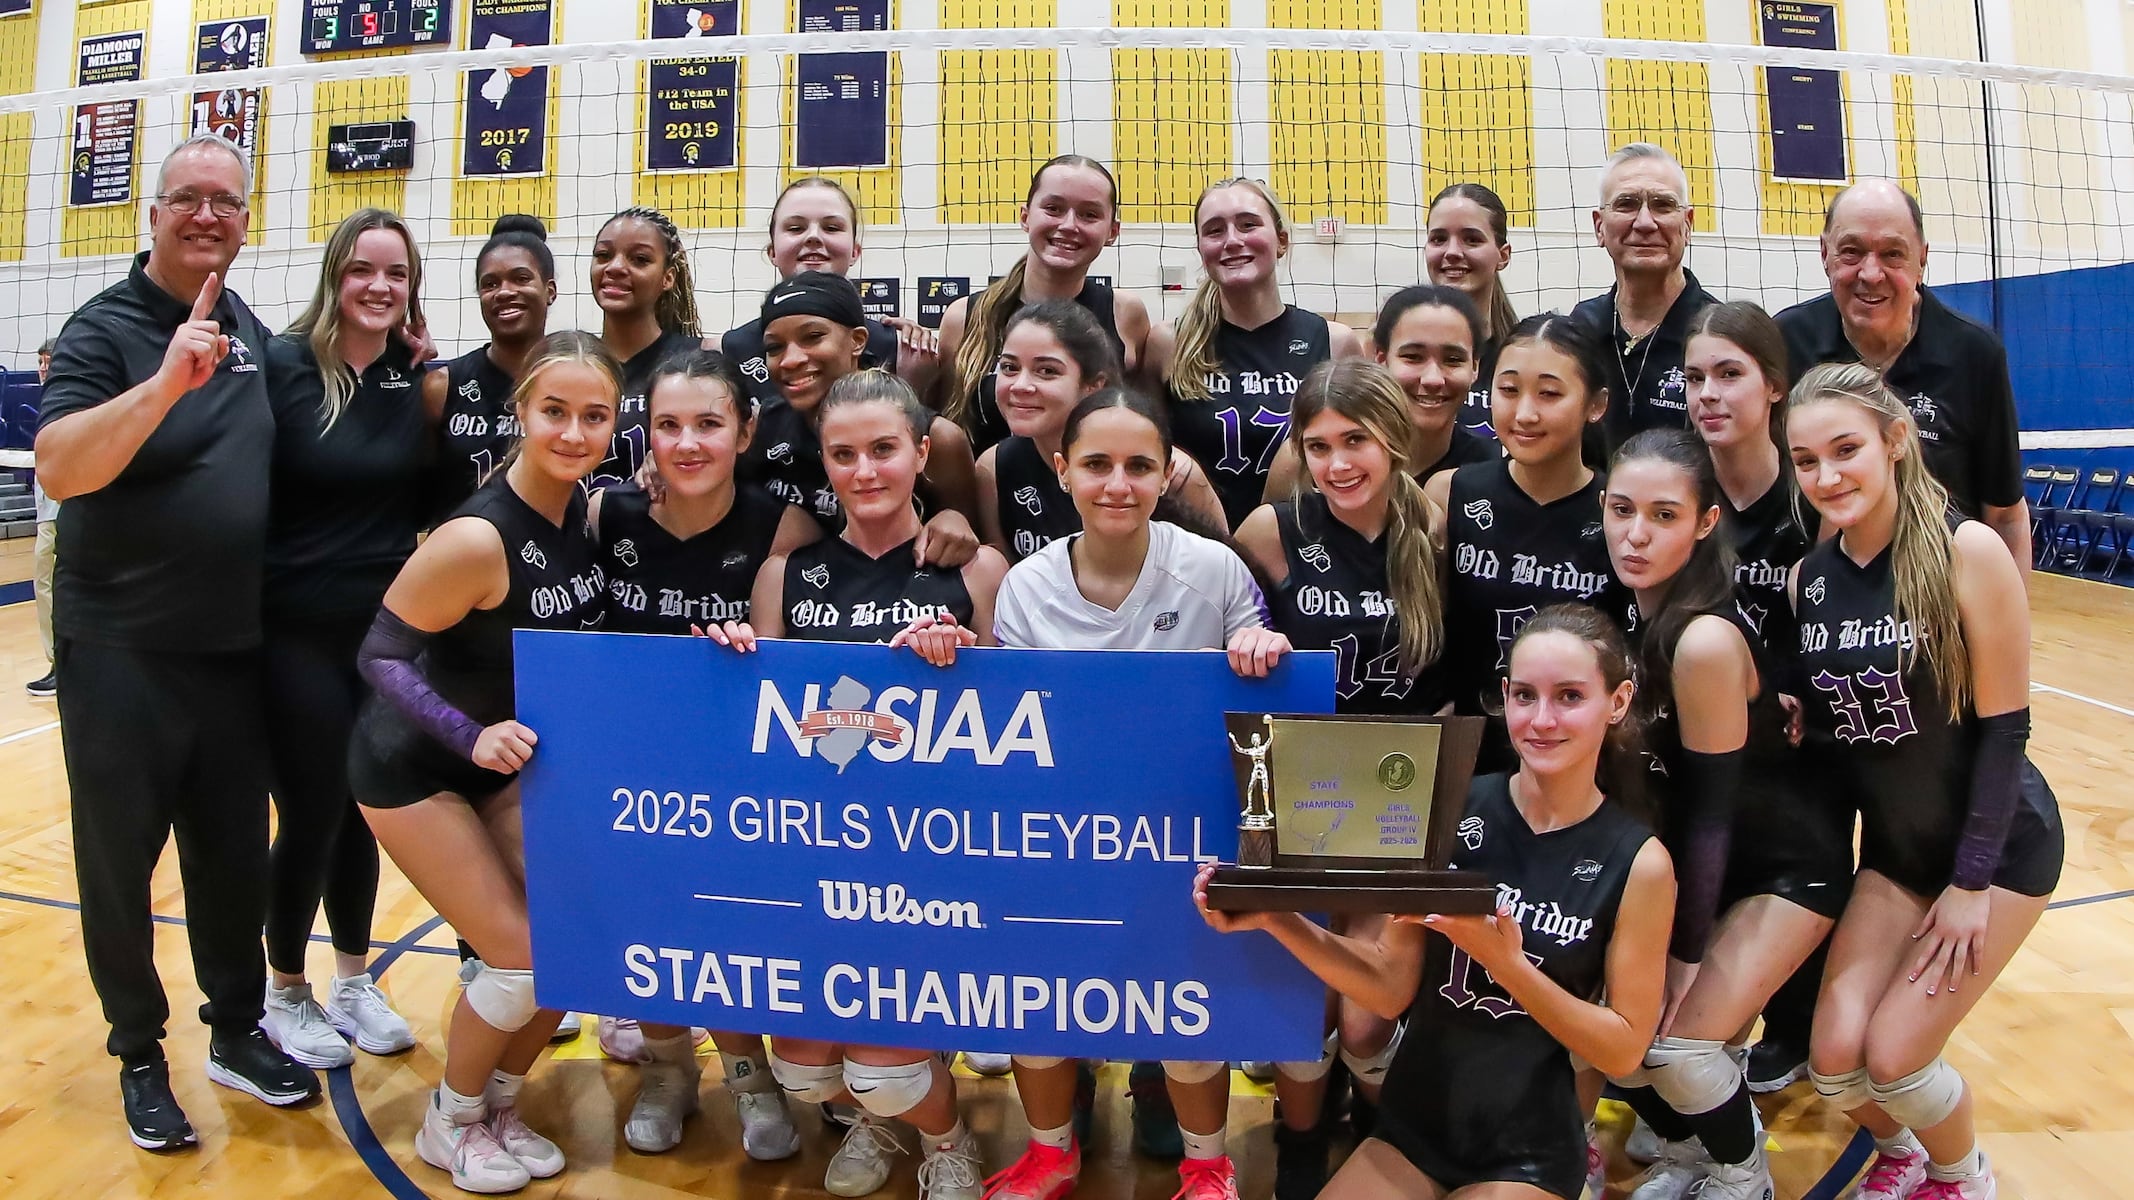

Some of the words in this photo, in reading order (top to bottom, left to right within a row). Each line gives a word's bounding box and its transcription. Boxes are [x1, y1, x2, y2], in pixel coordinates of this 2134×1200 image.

[313, 6, 338, 17] FOULS
[359, 3, 371, 13] NO
[495, 4, 547, 14] CHAMPIONS
[1776, 4, 1802, 12] GIRLS
[363, 13, 378, 35] 5
[424, 9, 438, 30] 2
[1777, 13, 1820, 23] SWIMMING
[325, 17, 338, 40] 3
[414, 31, 432, 41] WON
[82, 38, 140, 56] DIAMOND
[315, 40, 332, 49] WON
[362, 35, 384, 45] GAME
[88, 51, 133, 67] MILLER
[679, 66, 707, 76] 34-0
[658, 89, 679, 99] #12
[681, 88, 713, 98] Team
[716, 87, 728, 97] in
[669, 101, 689, 110] the
[692, 100, 716, 109] USA
[76, 114, 92, 148] 1
[481, 128, 530, 146] 2017
[665, 121, 719, 139] 2019
[922, 305, 940, 313] FIND
[1239, 370, 1304, 396] Brid
[449, 412, 489, 436] Old
[1214, 405, 1293, 475] 17
[1455, 542, 1500, 580] Old
[1510, 553, 1608, 600] Bridge
[1734, 559, 1788, 592] ridg
[531, 585, 573, 619] Old
[1297, 585, 1350, 617] Old
[791, 599, 840, 628] Old
[1838, 614, 1928, 650] Bridg
[1811, 665, 1919, 745] 33
[826, 713, 845, 725] Est.
[848, 713, 875, 727] 1918
[1310, 781, 1338, 790] STATE
[1294, 800, 1354, 809] CHAMPIONS
[612, 788, 713, 838] 2025
[728, 796, 872, 850] GIRLS
[886, 806, 1219, 863] VOLLEYBALL
[1375, 815, 1421, 823] VOLLEYBALL
[819, 879, 982, 928] Wilson
[1496, 882, 1594, 947] Bridge
[624, 943, 804, 1014] STATE
[822, 962, 1211, 1037] CHAMPIONS
